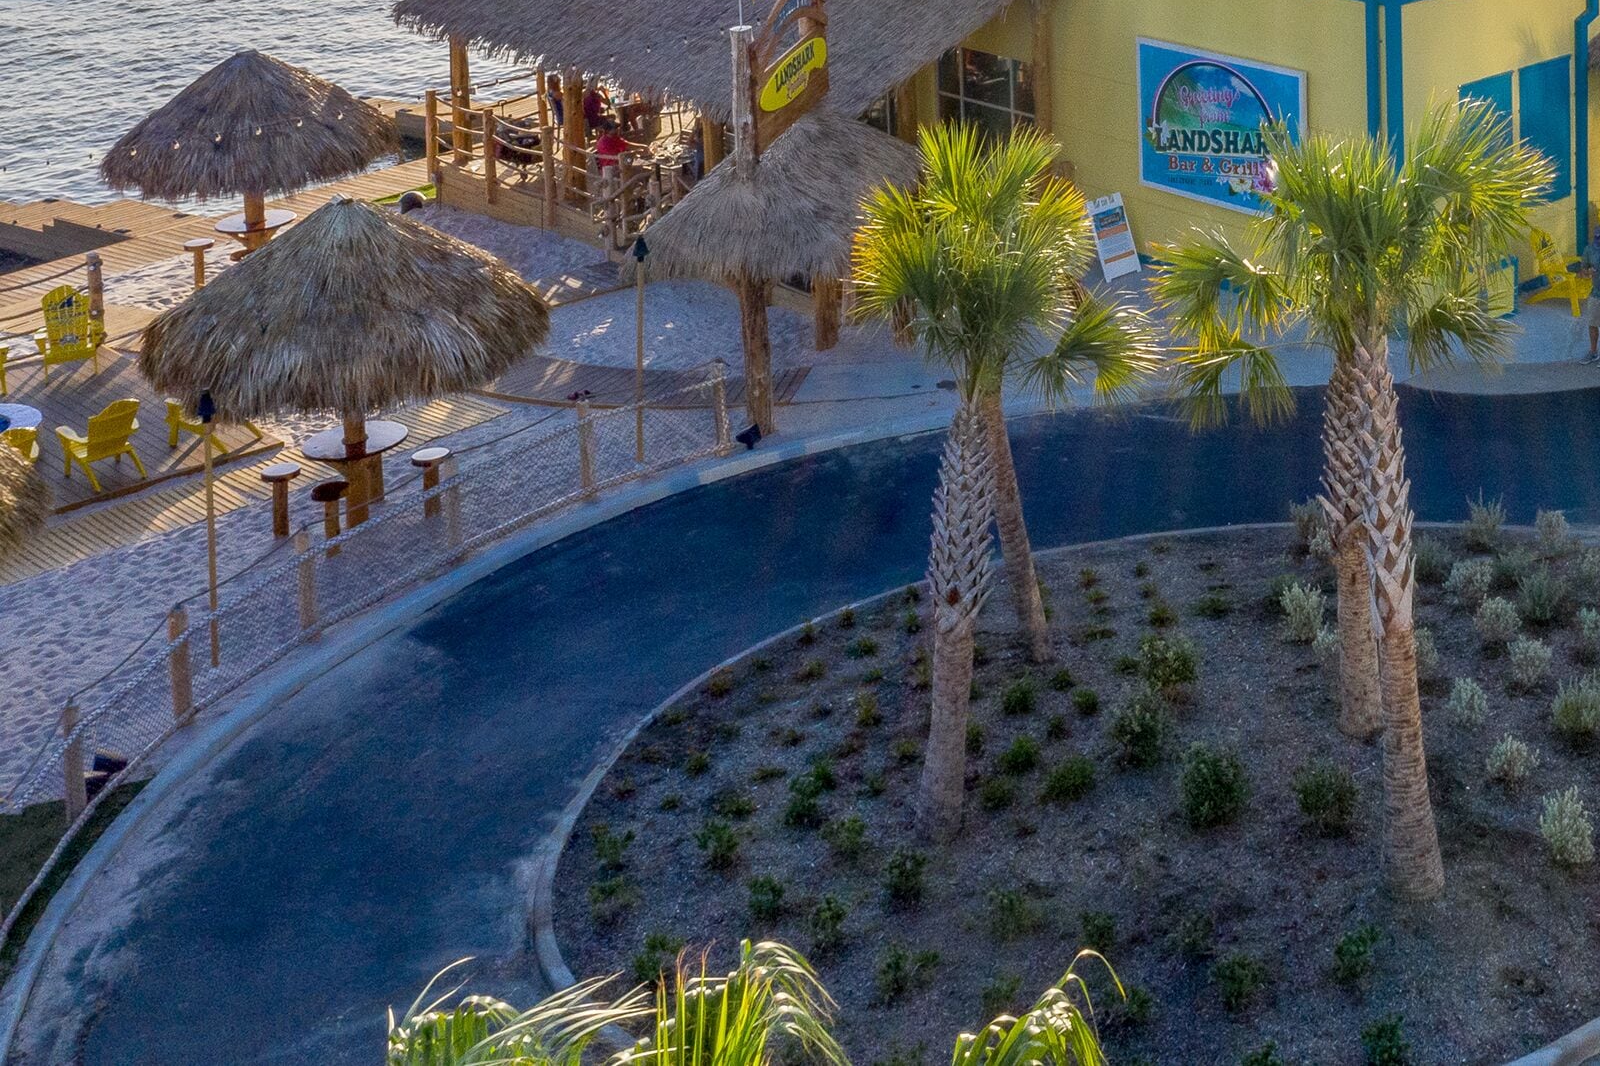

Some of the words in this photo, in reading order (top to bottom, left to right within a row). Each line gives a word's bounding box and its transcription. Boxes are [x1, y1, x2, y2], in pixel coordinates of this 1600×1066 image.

[1168, 155, 1197, 172] Bar
[1201, 157, 1214, 173] &
[1219, 158, 1261, 177] Grill
